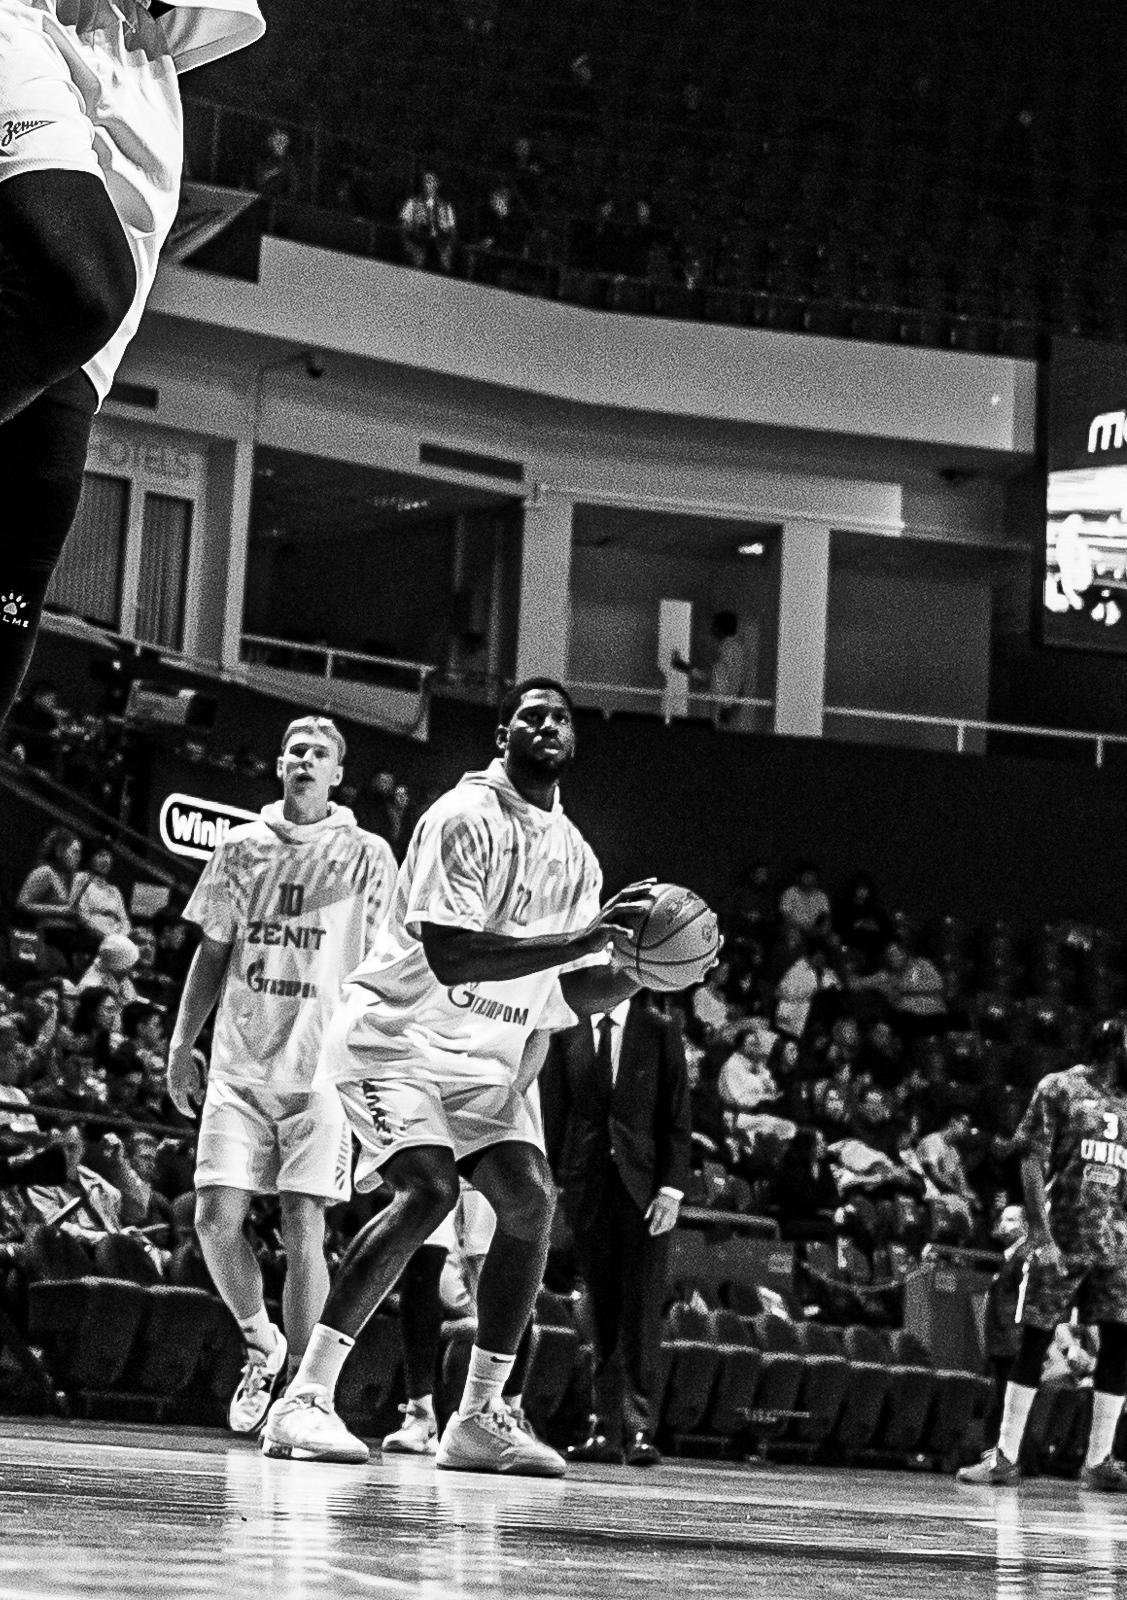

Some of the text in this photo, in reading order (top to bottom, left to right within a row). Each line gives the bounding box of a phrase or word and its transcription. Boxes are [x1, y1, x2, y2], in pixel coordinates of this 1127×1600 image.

[171, 806, 230, 848] Winl
[278, 882, 304, 917] 10
[247, 920, 326, 950] ZENIT
[1103, 1111, 1119, 1140] 3
